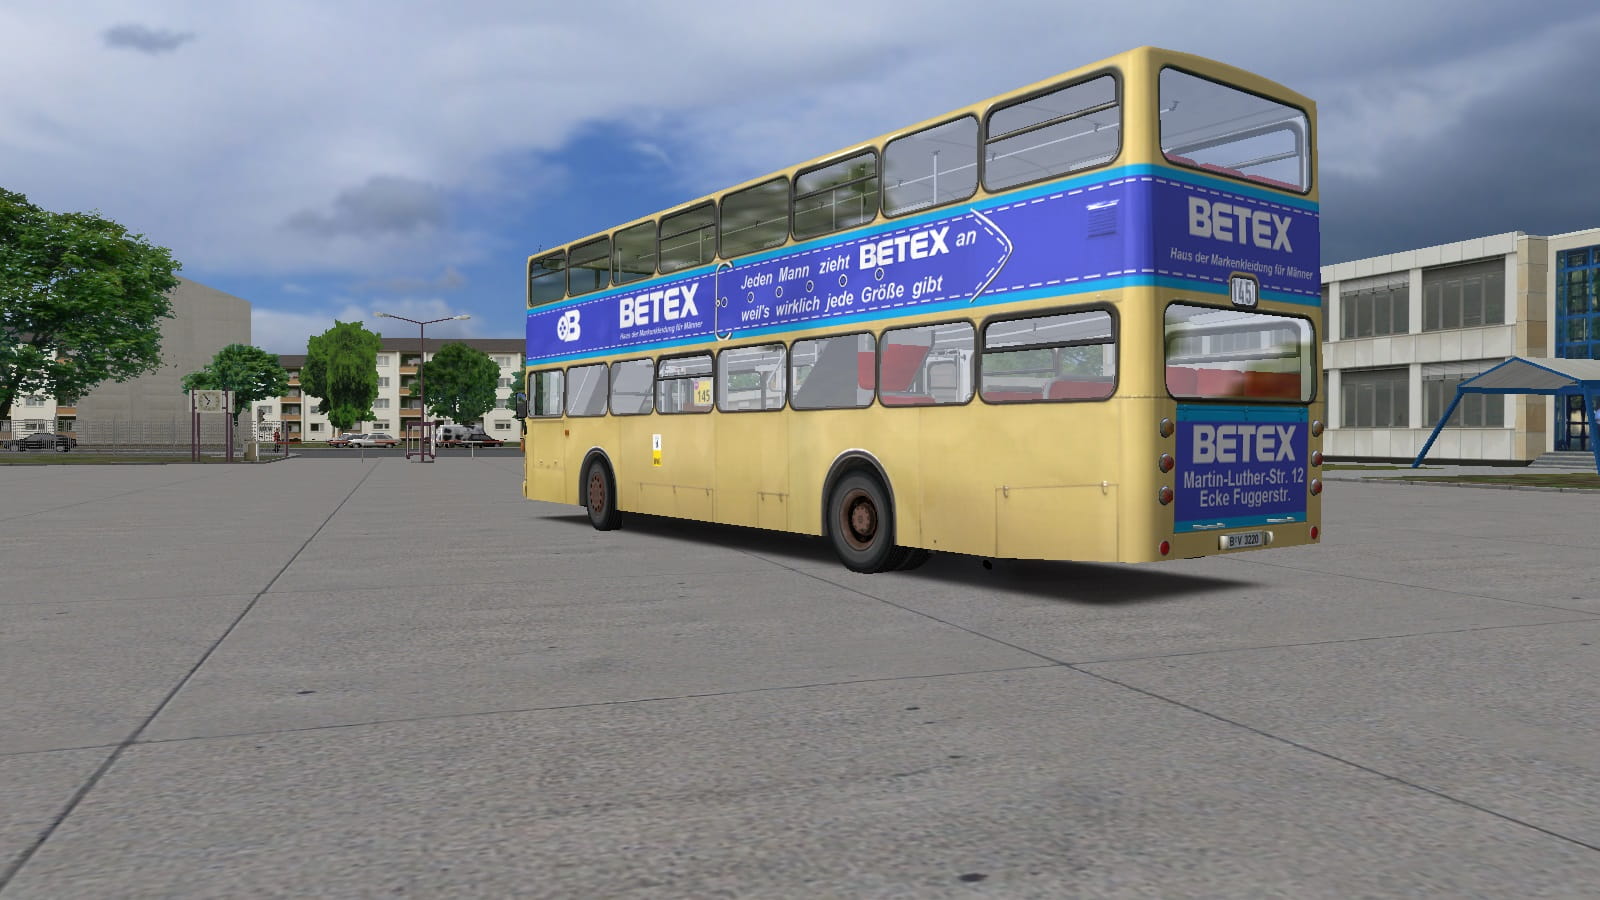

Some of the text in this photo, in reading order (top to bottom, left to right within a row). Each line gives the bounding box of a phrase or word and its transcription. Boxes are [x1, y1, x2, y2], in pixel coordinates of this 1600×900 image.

[1188, 196, 1293, 253] BETEX
[741, 226, 977, 290] Jeden Mann zieht BETEX an
[1170, 247, 1314, 281] Haus der Markenkleidung für Männer
[619, 283, 699, 329] BETEX
[741, 275, 943, 322] weil's wirklich jede Größe gibt
[1232, 278, 1252, 304] 145
[684, 320, 703, 330] Männer
[697, 389, 711, 403] 145
[1192, 424, 1296, 464] BETEX
[1183, 467, 1304, 489] Martin-Luther-Str. 12
[1199, 486, 1291, 508] Ecke Fuggerstr.
